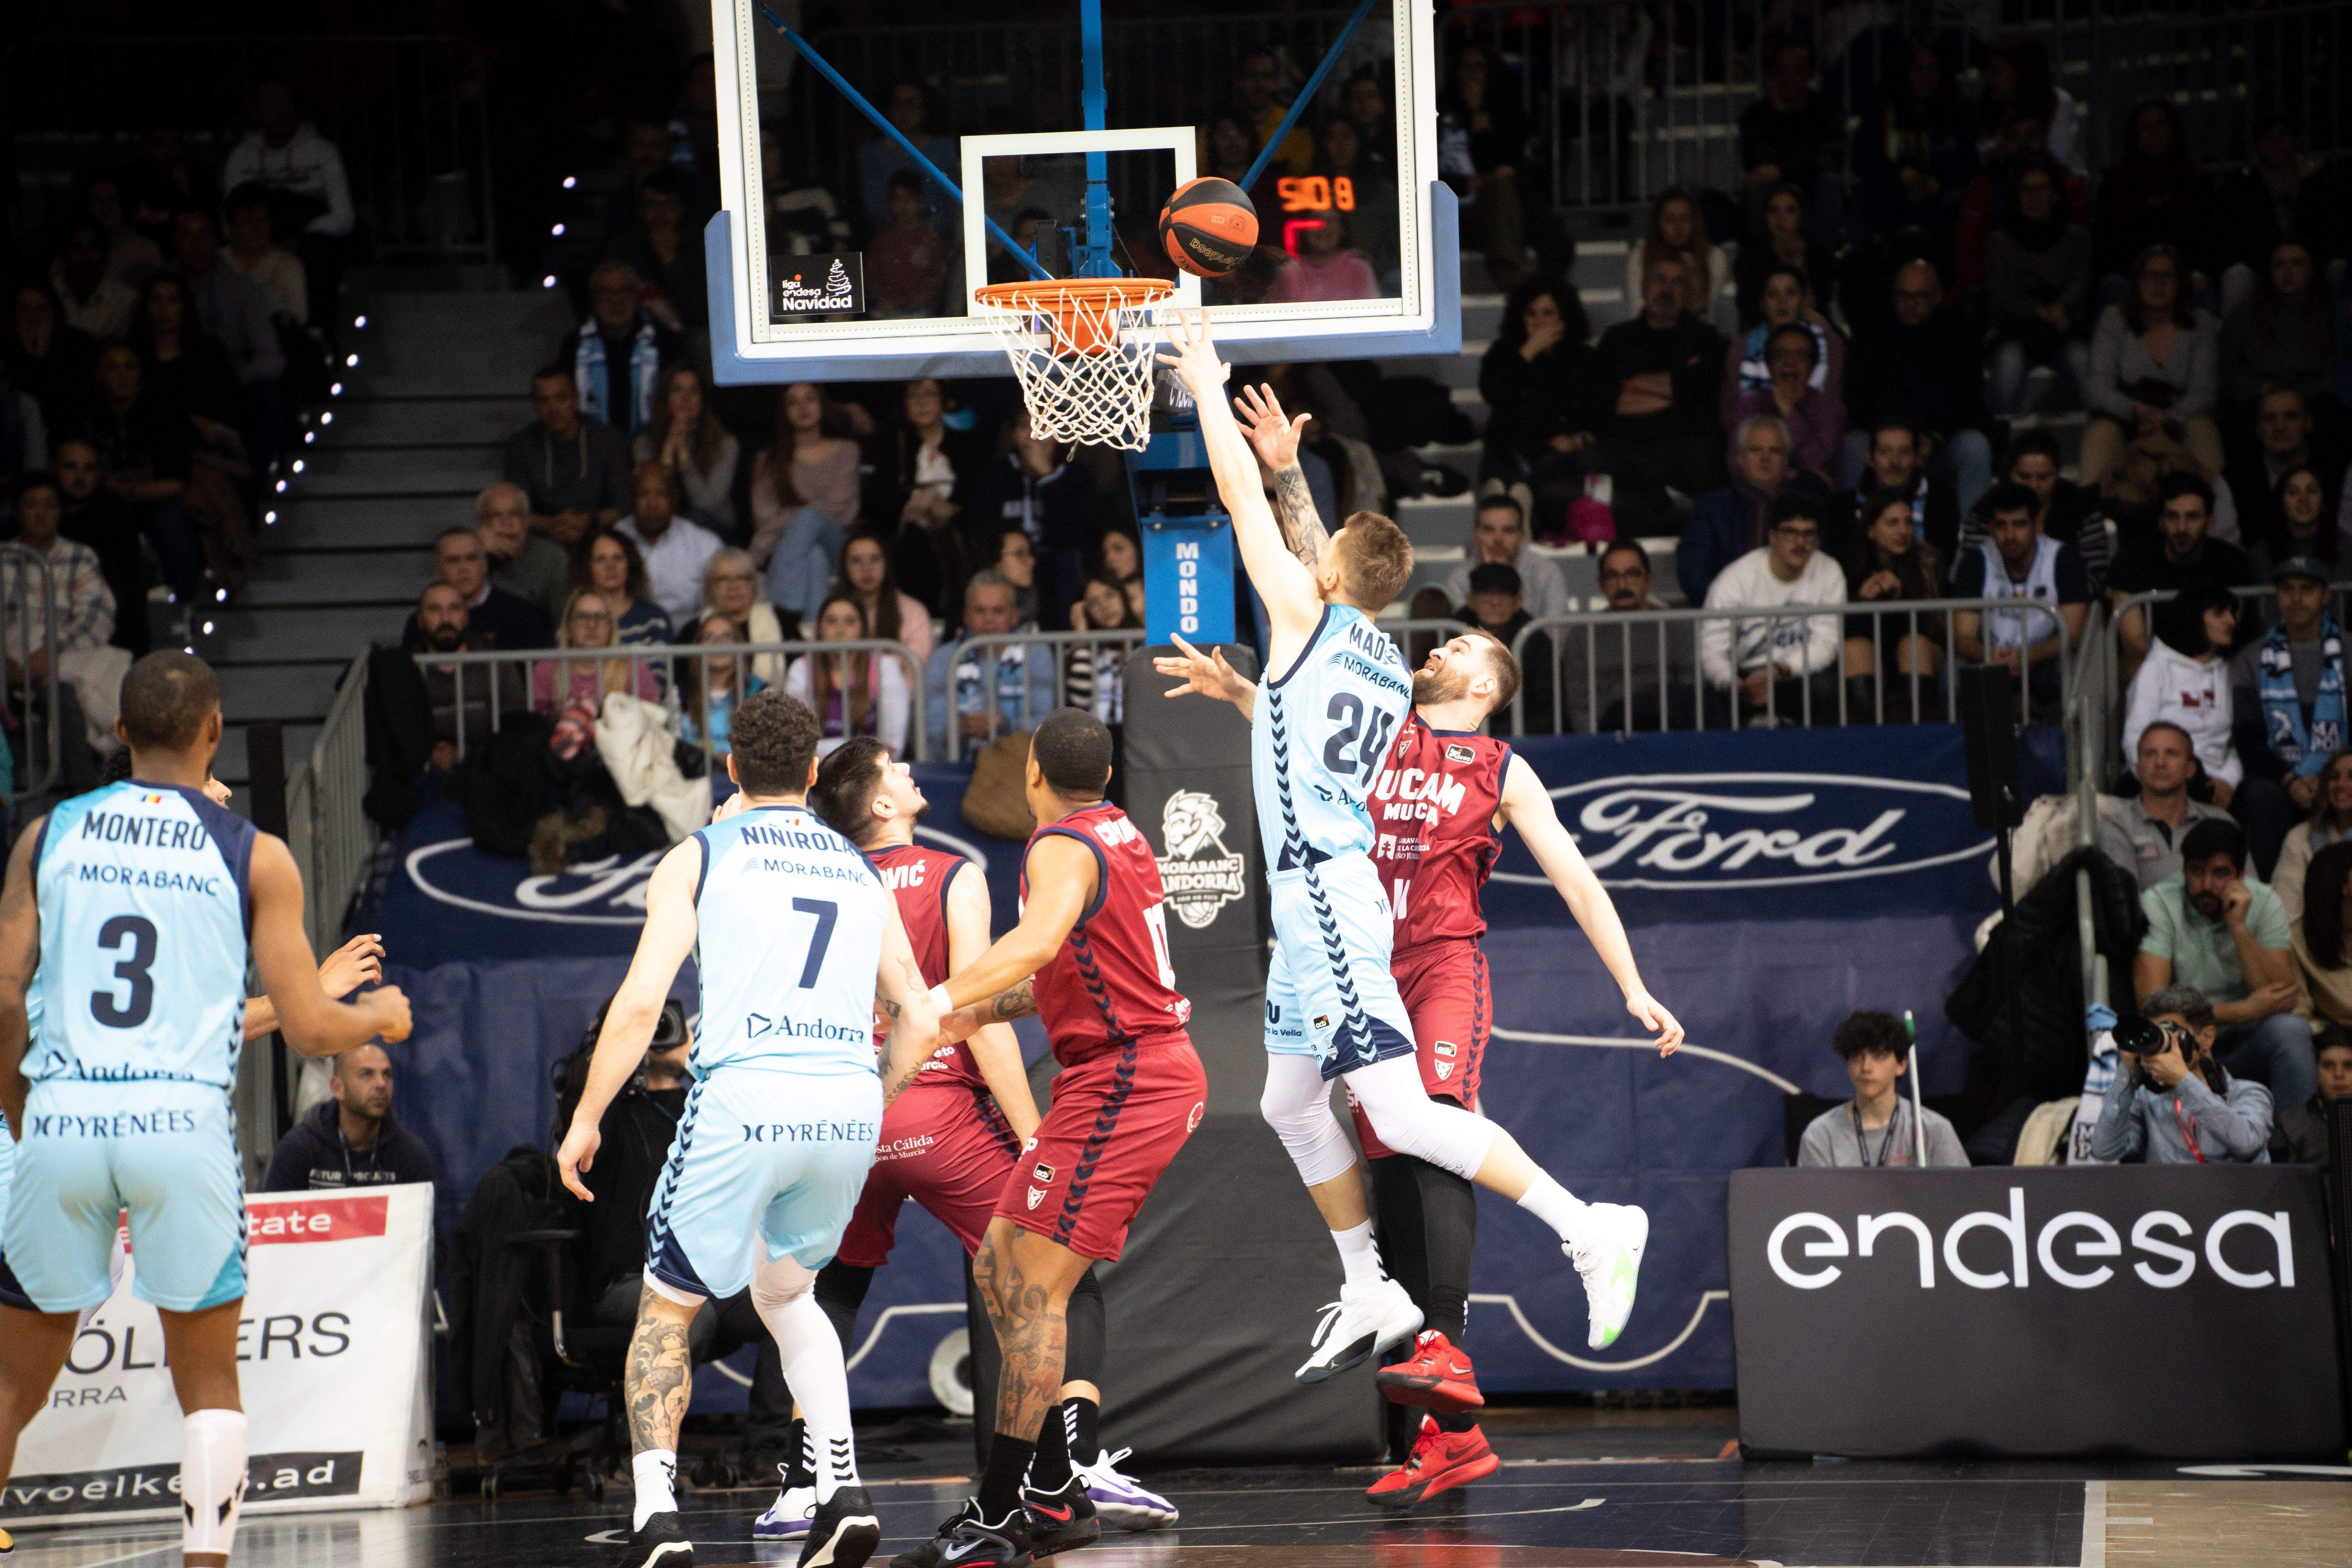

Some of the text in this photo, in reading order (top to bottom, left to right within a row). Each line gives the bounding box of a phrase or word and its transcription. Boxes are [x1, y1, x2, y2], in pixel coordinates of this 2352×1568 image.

[1190, 238, 1234, 264] endesa
[782, 279, 800, 290] liga
[783, 288, 821, 297] endesa
[783, 295, 853, 311] Navidad
[1176, 542, 1199, 634] MONDO
[1324, 692, 1395, 789] 24
[1375, 768, 1466, 816] UCAM
[82, 810, 209, 851] MONTERO
[741, 824, 858, 857] NIÑIROLA
[1570, 789, 1907, 872] Ford
[80, 863, 220, 896] MORABANC
[764, 858, 867, 886] MORABANC
[880, 859, 926, 890] VIĆ
[1156, 859, 1239, 875] MORABANC
[792, 897, 838, 989] 7
[90, 915, 158, 1029] 3
[775, 1015, 864, 1044] Andorra
[875, 1134, 934, 1154] sta Cálida
[898, 1148, 926, 1158] Murcia
[249, 1210, 332, 1236] tate
[1767, 1187, 2296, 1289] endesa
